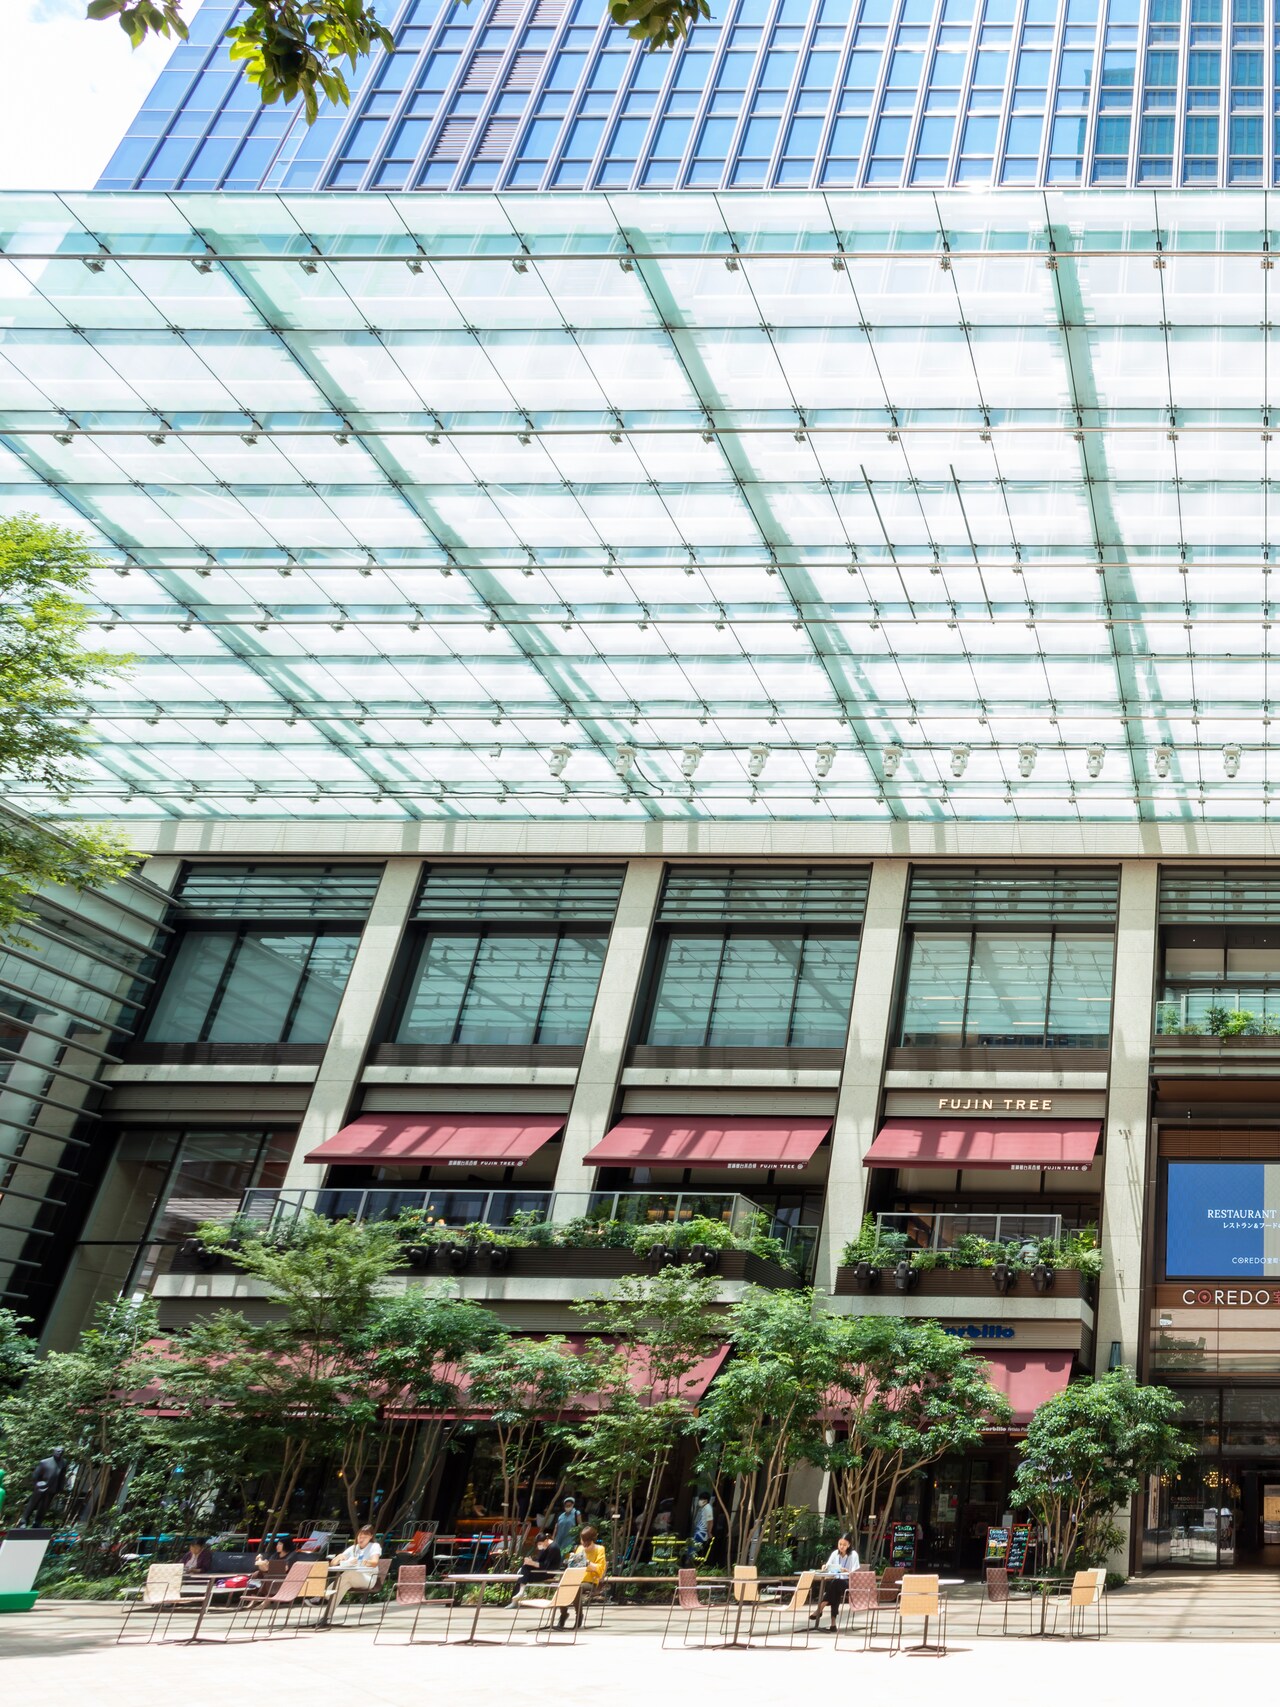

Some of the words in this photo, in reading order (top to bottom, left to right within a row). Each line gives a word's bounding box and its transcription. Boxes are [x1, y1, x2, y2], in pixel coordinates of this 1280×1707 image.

[938, 1098, 993, 1110] FUJIN
[1003, 1099, 1052, 1110] TREE
[1207, 1209, 1277, 1219] RESTAURANT
